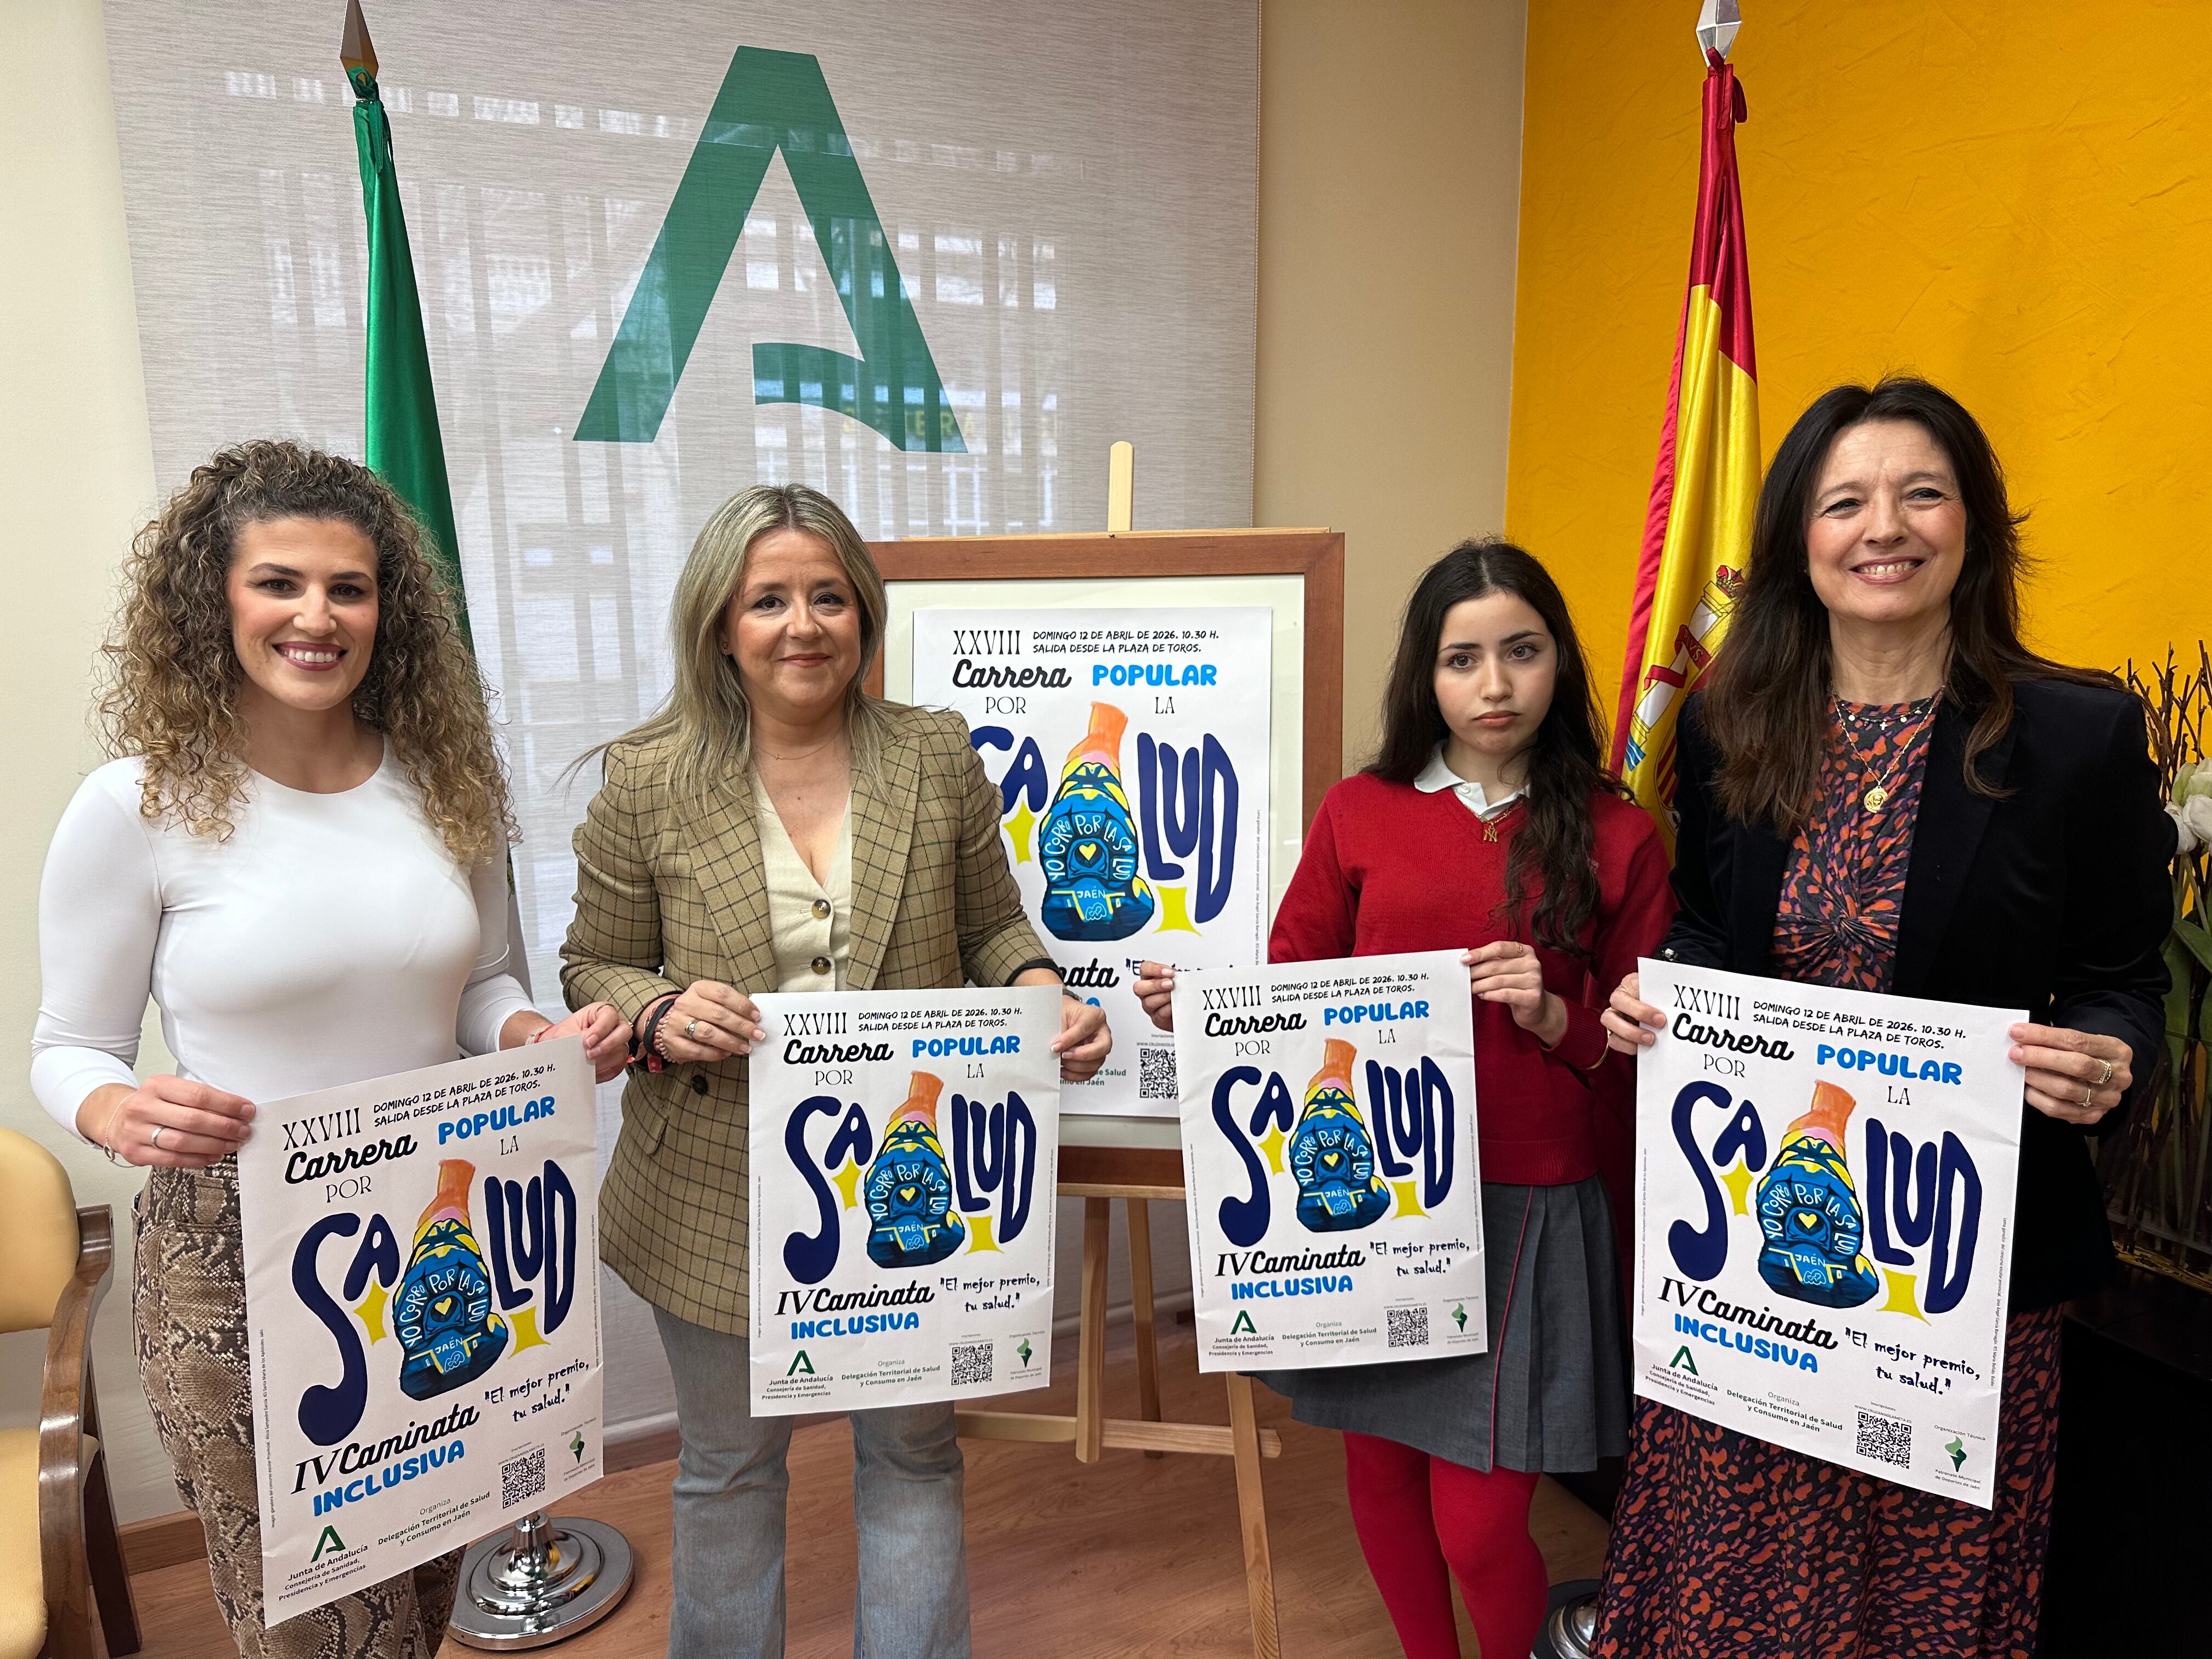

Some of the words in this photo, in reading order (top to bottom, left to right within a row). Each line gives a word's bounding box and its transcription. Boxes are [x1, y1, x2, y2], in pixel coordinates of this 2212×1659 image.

[952, 630, 1020, 655] XXVIII
[1032, 631, 1077, 641] DOMINGO
[1079, 631, 1088, 640] 12
[1091, 631, 1103, 640] DE
[1105, 630, 1135, 641] ABRIL
[1137, 630, 1150, 640] DE
[1152, 630, 1178, 640] 2026.
[1182, 630, 1207, 640] 10.30
[1209, 630, 1219, 639] H.
[1032, 644, 1066, 654] SALIDA
[1069, 644, 1100, 653] DESDE
[1102, 644, 1115, 654] LA
[1118, 643, 1149, 654] PLAZA
[1152, 644, 1165, 652] DE
[1167, 644, 1201, 654] TOROS.
[952, 658, 1073, 689] Carrera
[1092, 664, 1217, 687] POPULAR
[985, 696, 1026, 714] POR
[1155, 696, 1175, 714] LA
[1045, 820, 1073, 855] CORRO
[1075, 815, 1102, 835] POR
[1103, 821, 1117, 842] LA
[1045, 860, 1065, 881] YO
[1076, 886, 1106, 899] JAÉN
[1201, 985, 1262, 1011] XXVIII
[1673, 984, 1741, 1022] XXVIII
[783, 1012, 847, 1036] XXVIII
[858, 1022, 889, 1032] SALIDA
[891, 1022, 919, 1030] DESDE
[921, 1021, 933, 1030] LA
[935, 1020, 962, 1030] PLAZA
[964, 1019, 976, 1028] DE
[978, 1018, 1008, 1028] TOROS.
[1204, 1012, 1307, 1037] Carrera
[1323, 1000, 1430, 1026] POPULAR
[1753, 1001, 1801, 1016] DOMINGO
[1803, 1009, 1814, 1018] 12
[1816, 1010, 1831, 1020] DE
[1833, 1012, 1866, 1025] ABRIL
[1869, 1018, 1884, 1028] DE
[1886, 1020, 1917, 1032] 2026.
[1921, 1025, 1951, 1036] 10.30
[1954, 1029, 1966, 1039] H.
[1753, 1013, 1789, 1028] SALIDA
[1792, 1019, 1826, 1032] DESDE
[1829, 1025, 1843, 1036] LA
[1847, 1028, 1882, 1042] PLAZA
[1886, 1033, 1901, 1043] DE
[1904, 1035, 1944, 1049] TOROS.
[783, 1039, 894, 1065] Carrera
[912, 1035, 1020, 1058] POPULAR
[1234, 1040, 1271, 1057] POR
[1378, 1028, 1396, 1045] LA
[1672, 1013, 1795, 1061] Carrera
[1816, 1043, 1962, 1086] POPULAR
[815, 1069, 853, 1086] POR
[967, 1063, 984, 1079] LA
[1104, 1068, 1127, 1076] Salud
[1703, 1053, 1746, 1078] POR
[1887, 1085, 1911, 1106] LA
[373, 1094, 420, 1114] DOMINGO
[422, 1092, 432, 1103] 12
[433, 1088, 447, 1100] DE
[449, 1082, 478, 1096] ABRIL
[479, 1077, 492, 1089] DE
[494, 1072, 519, 1086] 2026.
[522, 1065, 545, 1079] 10.30
[546, 1063, 556, 1073] H.
[374, 1110, 410, 1127] SALIDA
[413, 1102, 444, 1118] DESDE
[447, 1098, 460, 1110] LA
[462, 1090, 492, 1107] PLAZA
[494, 1086, 507, 1098] DE
[509, 1079, 541, 1095] TOROS.
[281, 1107, 362, 1152] XXVIII
[284, 1133, 418, 1184] Carrera
[438, 1096, 555, 1146] POPULAR
[325, 1175, 372, 1204] POR
[500, 1135, 520, 1156] LA
[1214, 1251, 1256, 1277] IV
[1250, 1243, 1367, 1274] Caminata
[1369, 1241, 1387, 1255] "El
[1392, 1242, 1424, 1259] mejor
[1429, 1238, 1470, 1256] premio,
[1396, 1266, 1409, 1277] tu
[1413, 1257, 1451, 1274] salud."
[774, 1289, 819, 1316] IV
[812, 1279, 935, 1313] Caminata
[940, 1277, 958, 1291] "El
[963, 1277, 995, 1294] mejor
[999, 1272, 1040, 1291] premio,
[1231, 1274, 1353, 1300] INCLUSIVA
[964, 1301, 978, 1313] tu
[982, 1291, 1020, 1310] salud."
[1657, 1276, 1705, 1313] IV
[1697, 1289, 1839, 1350] Caminata
[791, 1311, 919, 1340] INCLUSIVA
[1282, 1331, 1317, 1341] Delegación
[1317, 1329, 1350, 1338] Territorial
[1315, 1321, 1342, 1329] Organiza
[1674, 1313, 1818, 1374] INCLUSIVA
[1845, 1327, 1867, 1349] "El
[1874, 1342, 1917, 1362] mejor
[1922, 1354, 1980, 1381] premio,
[484, 1386, 505, 1404] "El
[509, 1378, 543, 1398] mejor
[547, 1358, 589, 1388] premio,
[1651, 1363, 1671, 1375] Junta
[1672, 1371, 1681, 1379] de
[1682, 1374, 1718, 1391] Andalucía
[1875, 1366, 1893, 1380] tu
[1899, 1371, 1951, 1395] salud."
[512, 1409, 527, 1423] tu
[531, 1383, 570, 1414] salud."
[1726, 1389, 1768, 1407] Delegación
[1768, 1402, 1808, 1420] Territorial
[1820, 1418, 1843, 1431] Salud
[1767, 1391, 1800, 1407] Organiza
[1753, 1406, 1788, 1422] Consumo
[1801, 1421, 1820, 1432] Jaén
[290, 1447, 346, 1495] IV
[338, 1403, 481, 1475] Caminata
[313, 1440, 465, 1517] INCLUSIVA
[378, 1523, 420, 1545] Delegación
[421, 1505, 459, 1526] Territorial
[459, 1502, 469, 1510] de
[470, 1491, 490, 1505] Salud
[420, 1498, 451, 1515] Organiza
[400, 1539, 405, 1547] y
[406, 1523, 442, 1542] Consumo
[442, 1519, 452, 1527] en
[453, 1510, 471, 1522] Jaén
[287, 1567, 313, 1581] Junta
[314, 1562, 326, 1571] de
[326, 1544, 368, 1567] Andalucía
